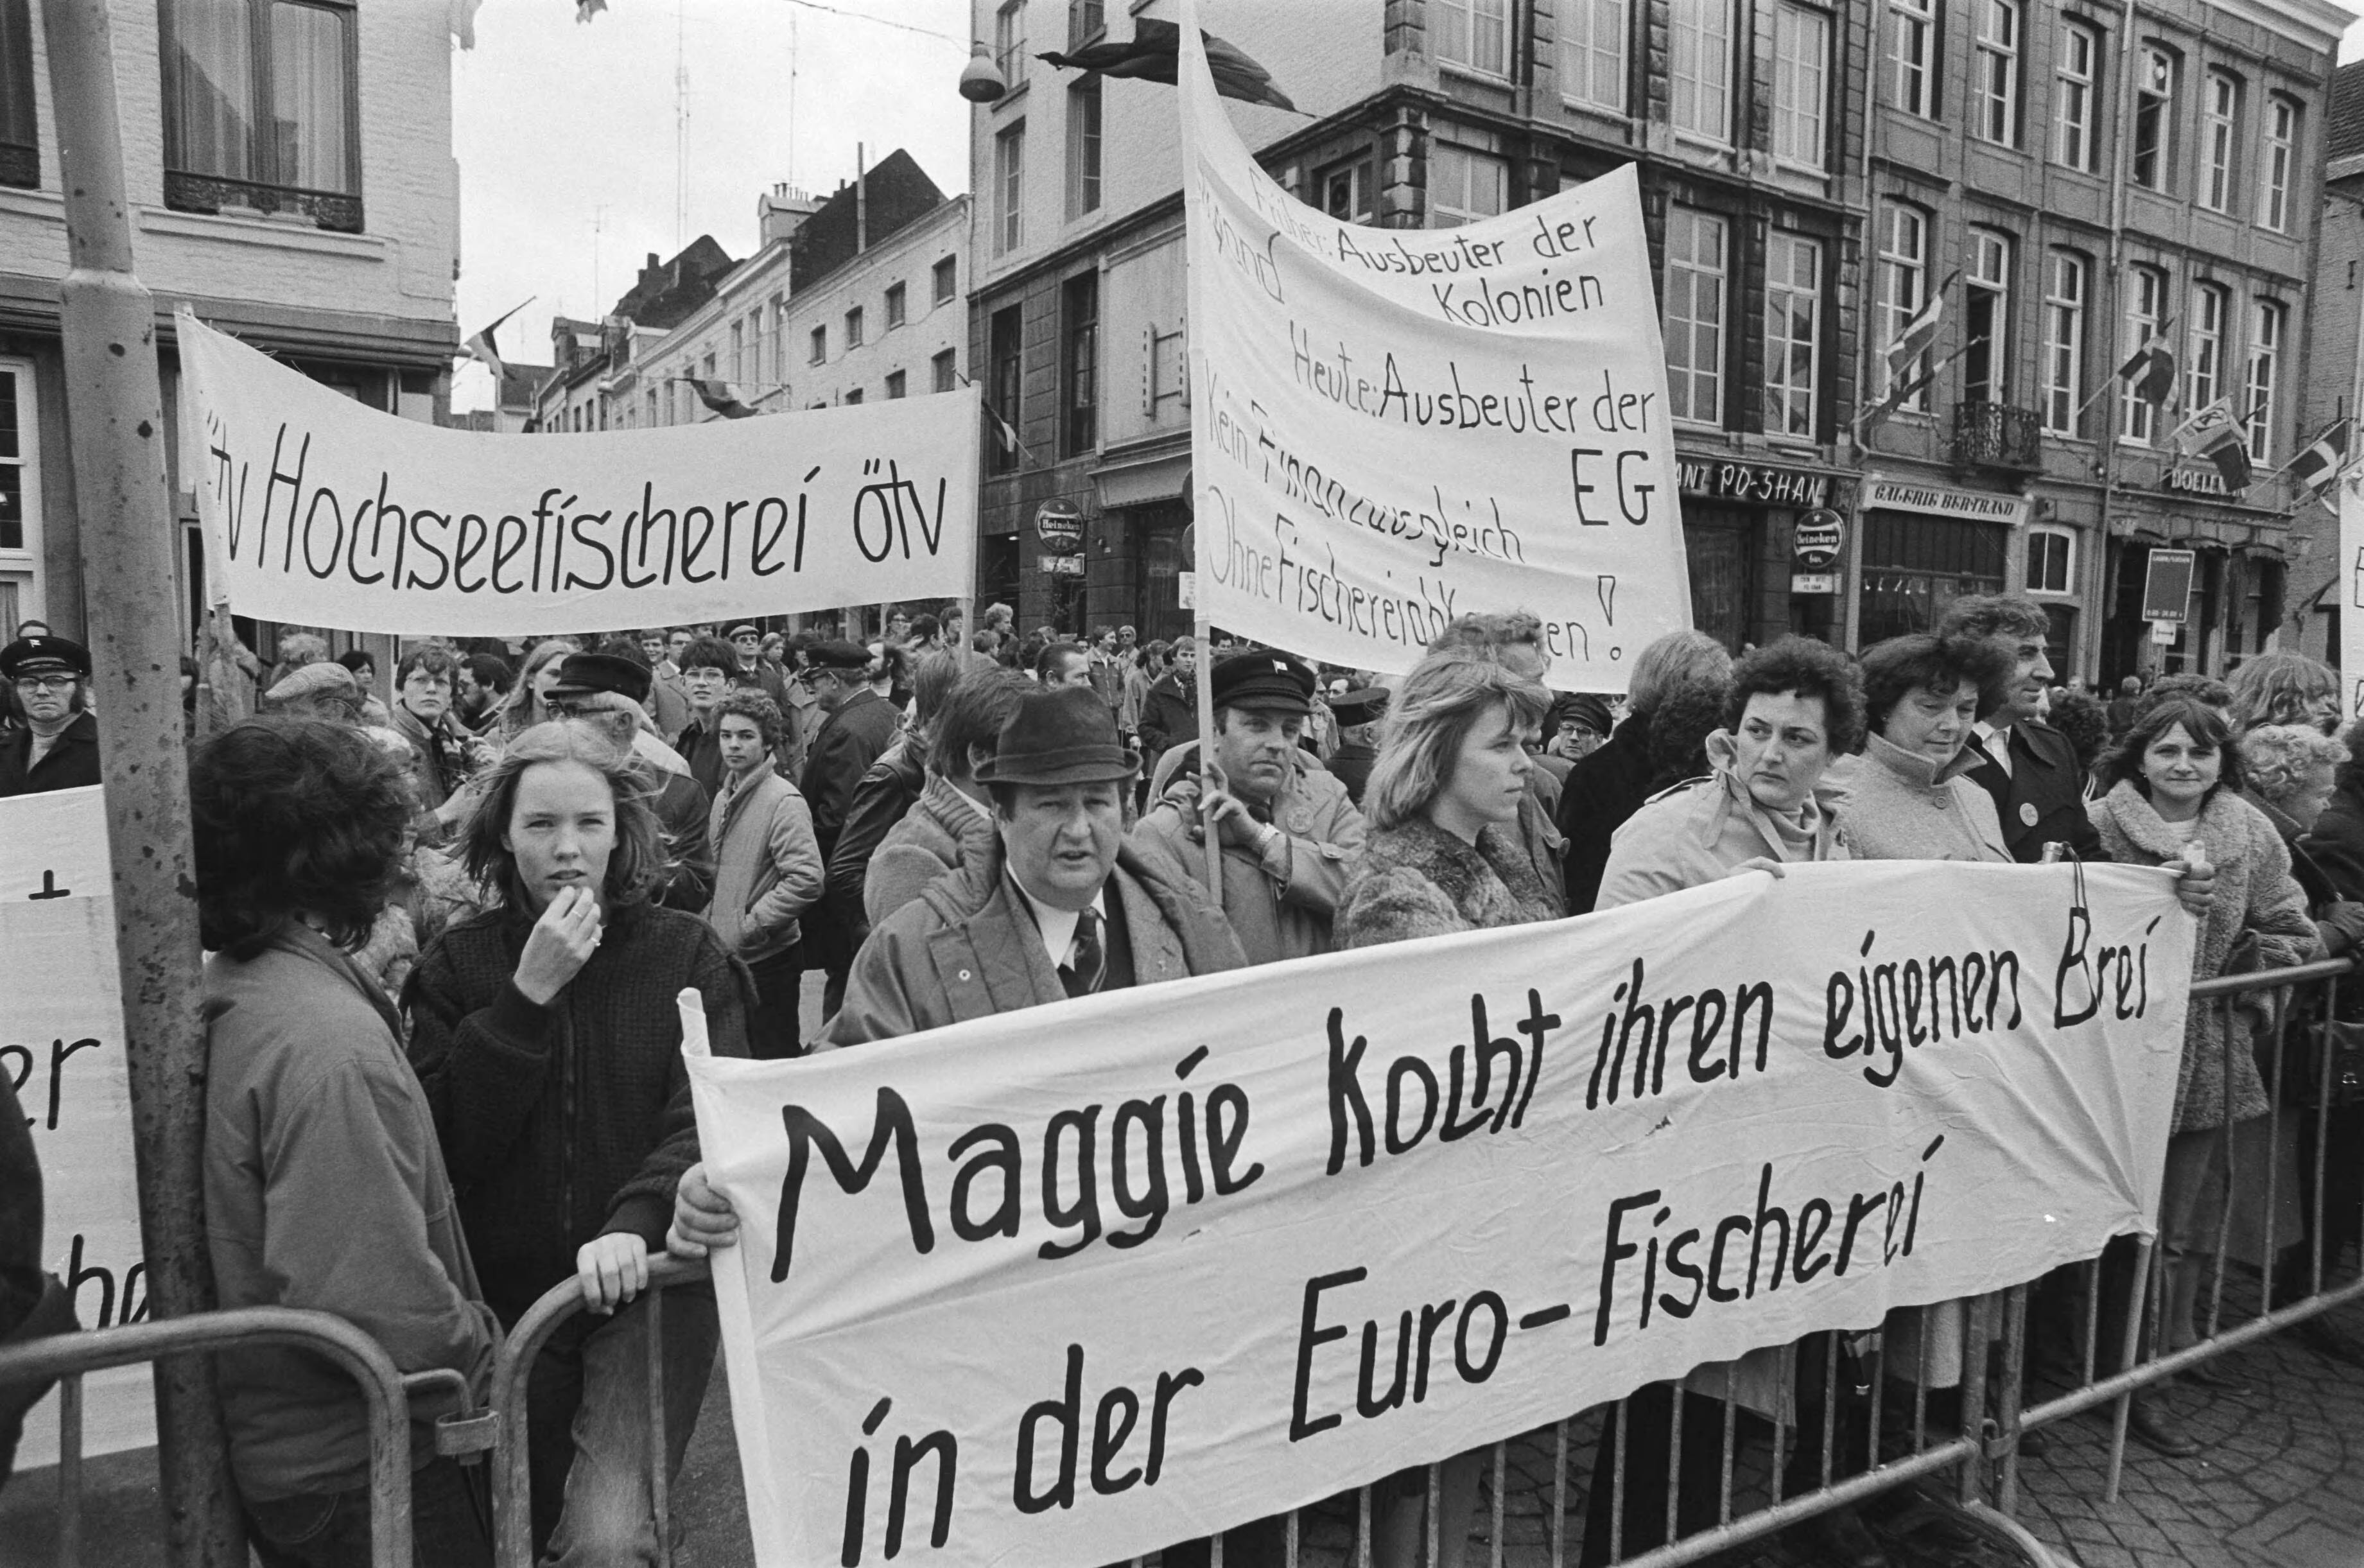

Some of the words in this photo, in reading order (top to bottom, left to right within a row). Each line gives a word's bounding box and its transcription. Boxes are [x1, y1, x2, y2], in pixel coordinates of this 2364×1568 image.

[1338, 227, 1505, 275] Ausbeuter
[1533, 214, 1597, 258] der
[1432, 268, 1604, 327] Kolonien
[1289, 319, 1378, 417] Heute:
[1378, 352, 1578, 433] Ausbeuter
[1593, 369, 1655, 433] der
[258, 422, 821, 593] Hochseefischerei
[1205, 358, 1248, 471] Kein
[1251, 399, 1525, 568] Finanzausgleich
[1571, 448, 1655, 526] EG
[1720, 464, 1823, 504] PO-SHAN
[1873, 483, 1939, 507] GALERIE
[1940, 493, 2015, 516] BERTRAND
[1208, 485, 1273, 598] Ohne
[770, 1045, 1265, 1284] Maggie
[1586, 957, 1774, 1110] ihren
[1823, 929, 2022, 1088] eigenen
[2055, 906, 2162, 1029] Brei
[841, 1397, 957, 1568] in
[1013, 1343, 1204, 1515] der
